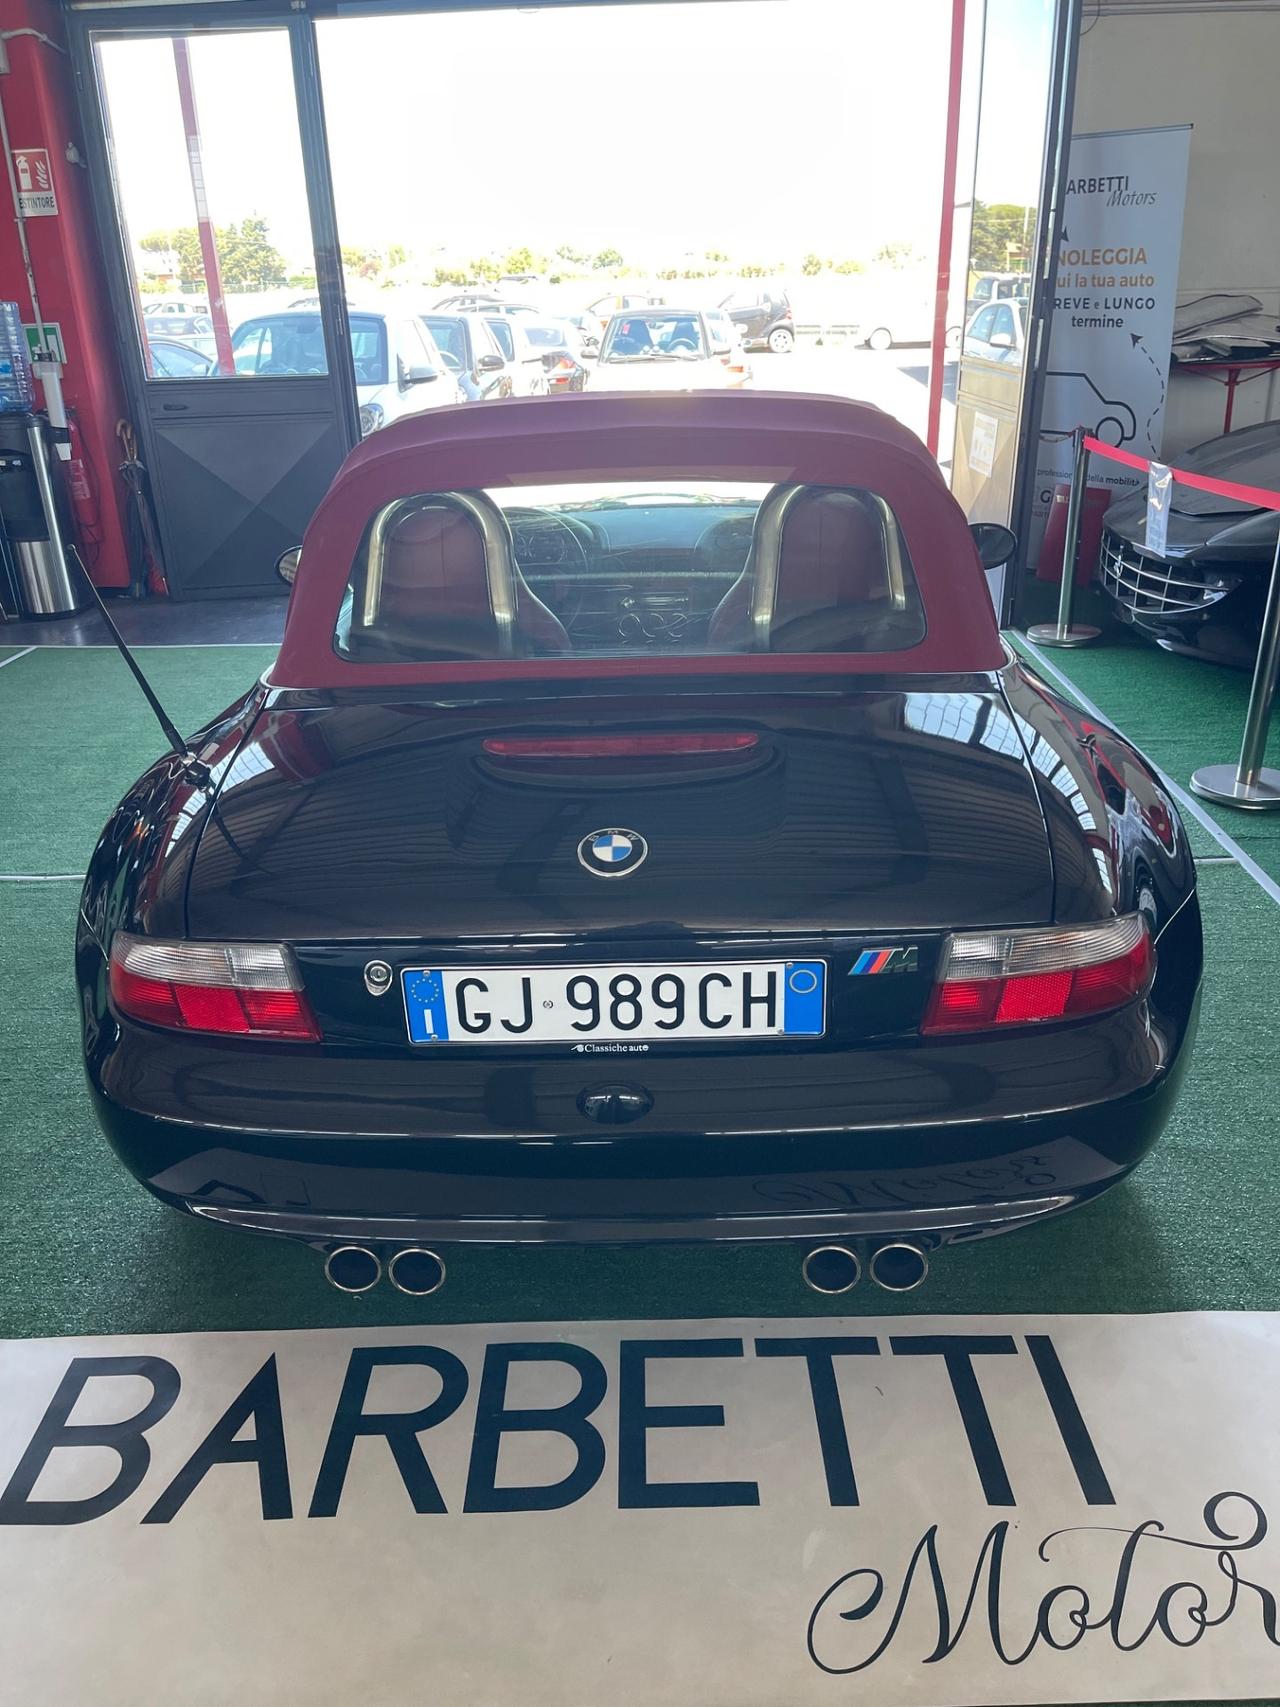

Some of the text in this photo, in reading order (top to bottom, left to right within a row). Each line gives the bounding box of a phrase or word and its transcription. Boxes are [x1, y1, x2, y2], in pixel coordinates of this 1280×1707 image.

[1066, 175, 1129, 195] ARBETTI
[18, 196, 55, 209] ESTINTORE
[1106, 190, 1158, 207] Motors
[1056, 272, 1155, 288] ui la tua auto
[1054, 297, 1156, 310] REVE e LUNGO
[1071, 313, 1124, 328] termine
[455, 970, 778, 1034] GJ 989CH
[423, 1008, 434, 1034] I
[584, 1043, 628, 1053] Classiche
[0, 1335, 1116, 1526] BARBETTI
[807, 1491, 1280, 1675] Motor
